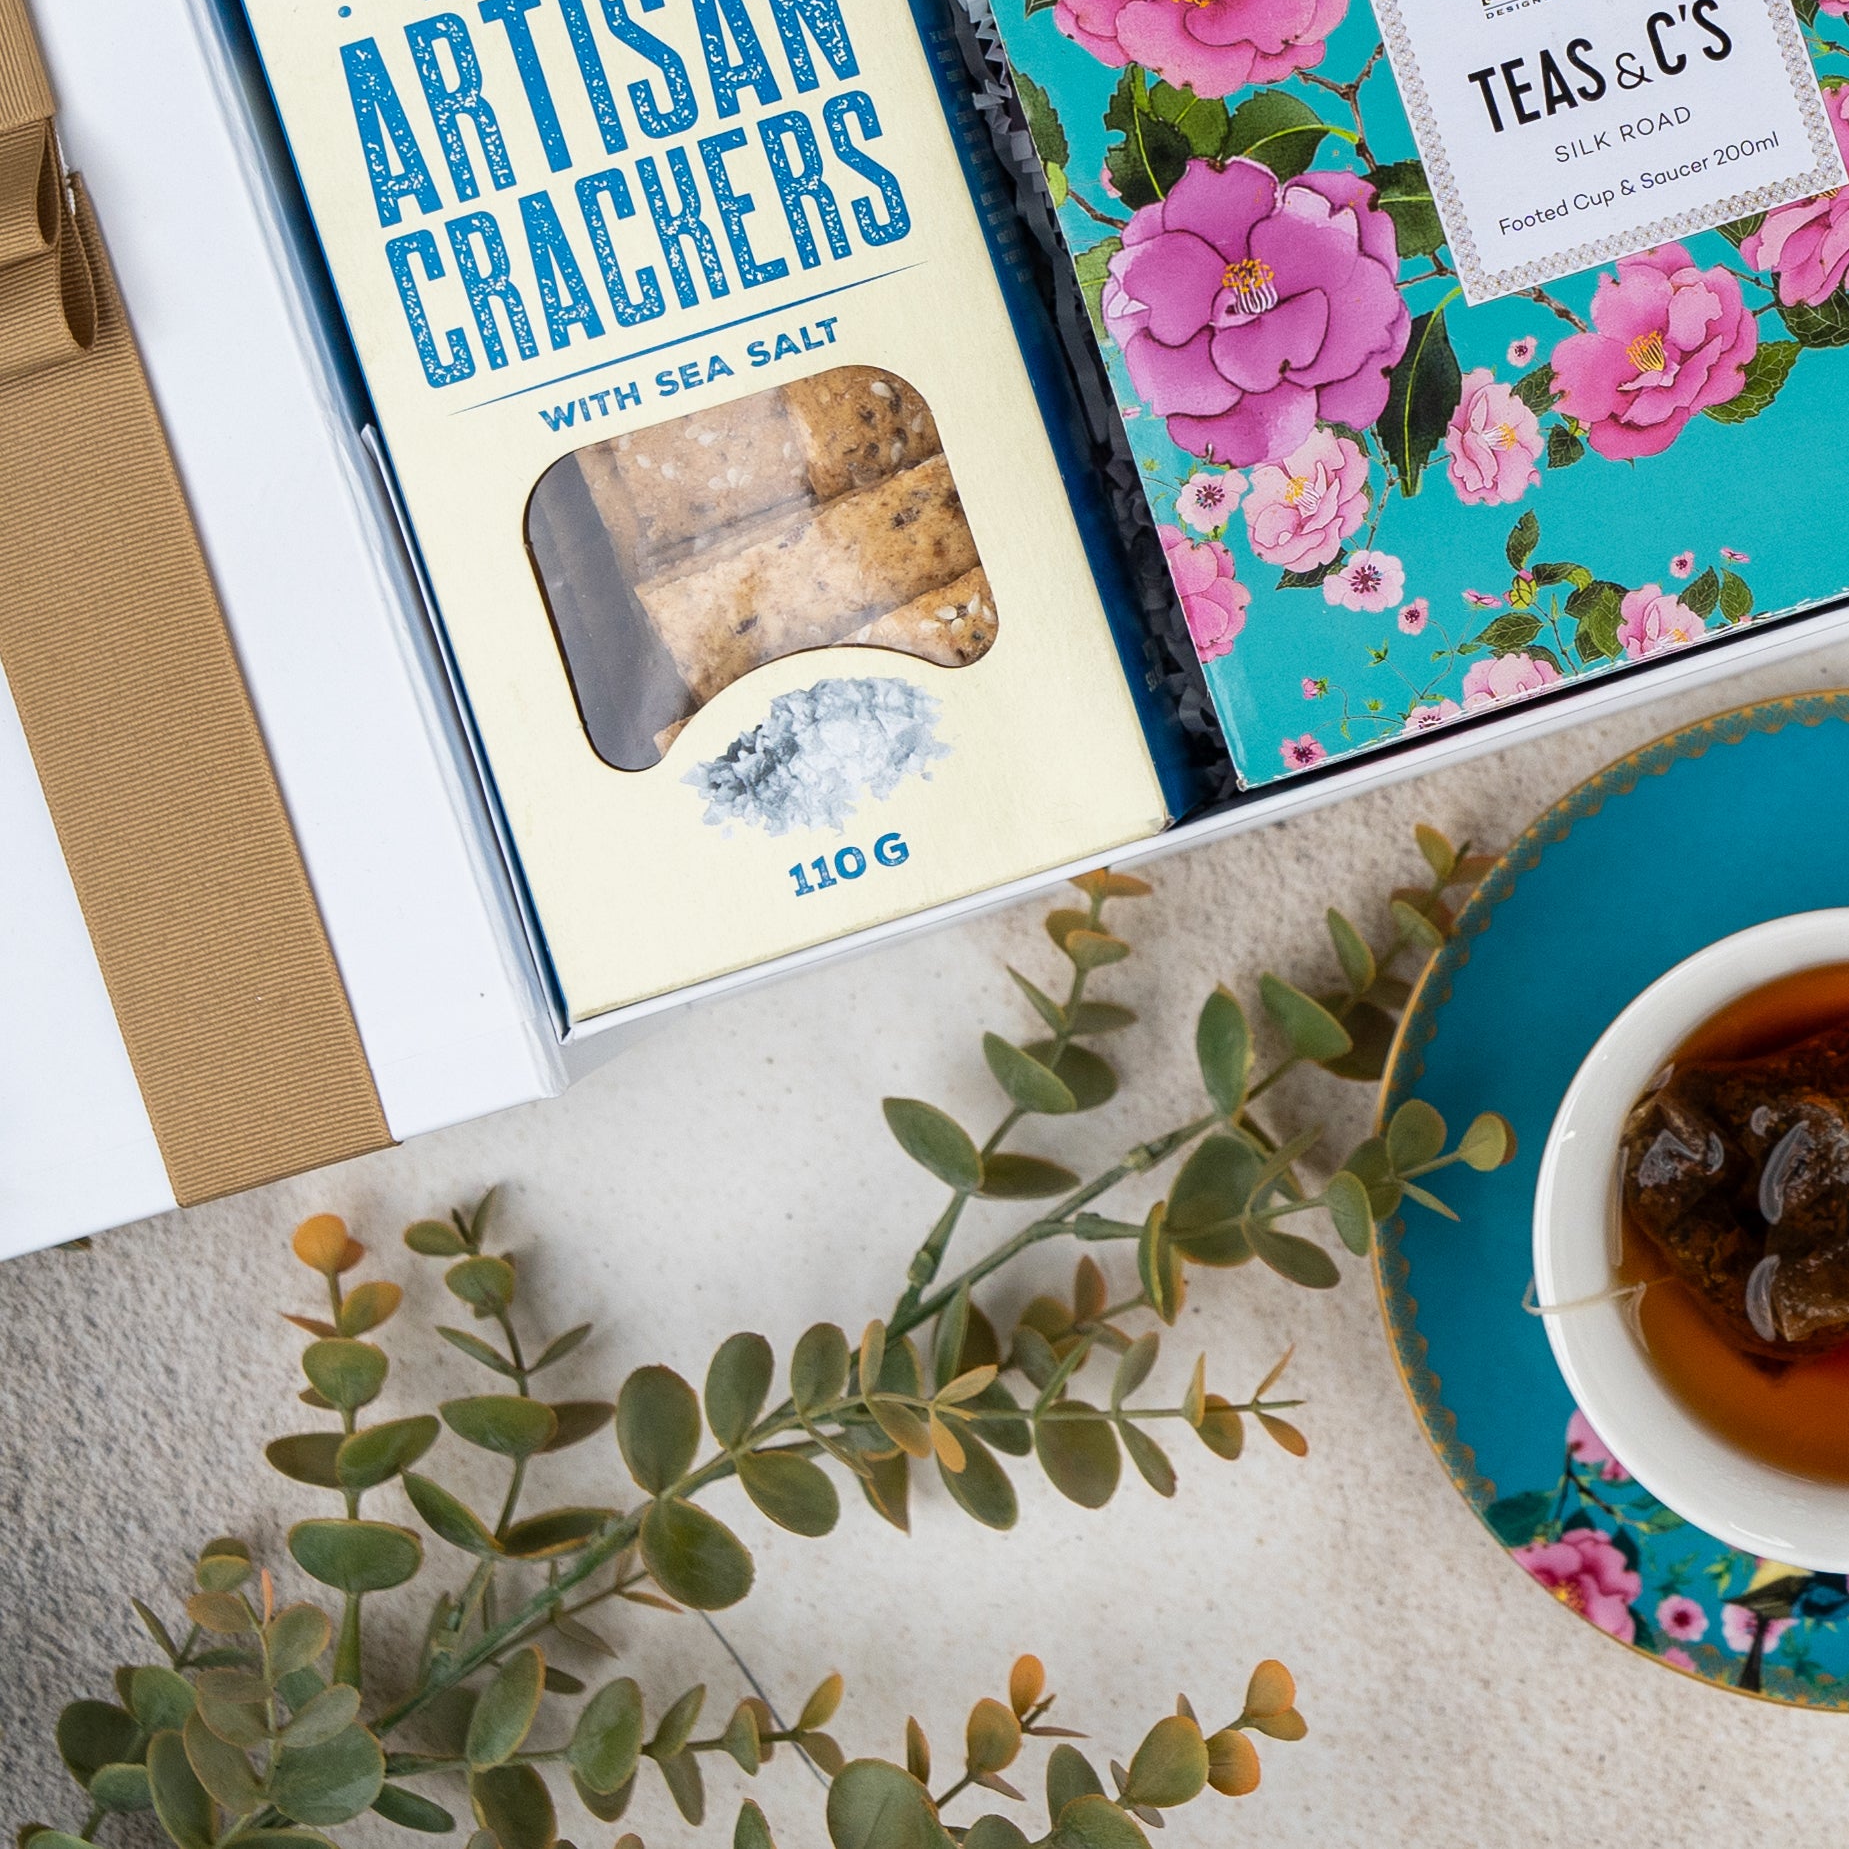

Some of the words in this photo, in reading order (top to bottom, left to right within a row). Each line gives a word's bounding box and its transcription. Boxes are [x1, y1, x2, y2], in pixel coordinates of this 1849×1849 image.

[1498, 198, 1569, 236] Footed
[1573, 189, 1615, 211] Cup
[1639, 157, 1709, 189] Saucer
[1713, 130, 1779, 166] 200ml
[1554, 131, 1611, 163] SILK
[1619, 106, 1691, 142] ROAD
[385, 90, 912, 389] CRACKERS
[538, 381, 642, 432] WITH
[655, 354, 734, 397] SEA
[746, 316, 838, 368] SALT
